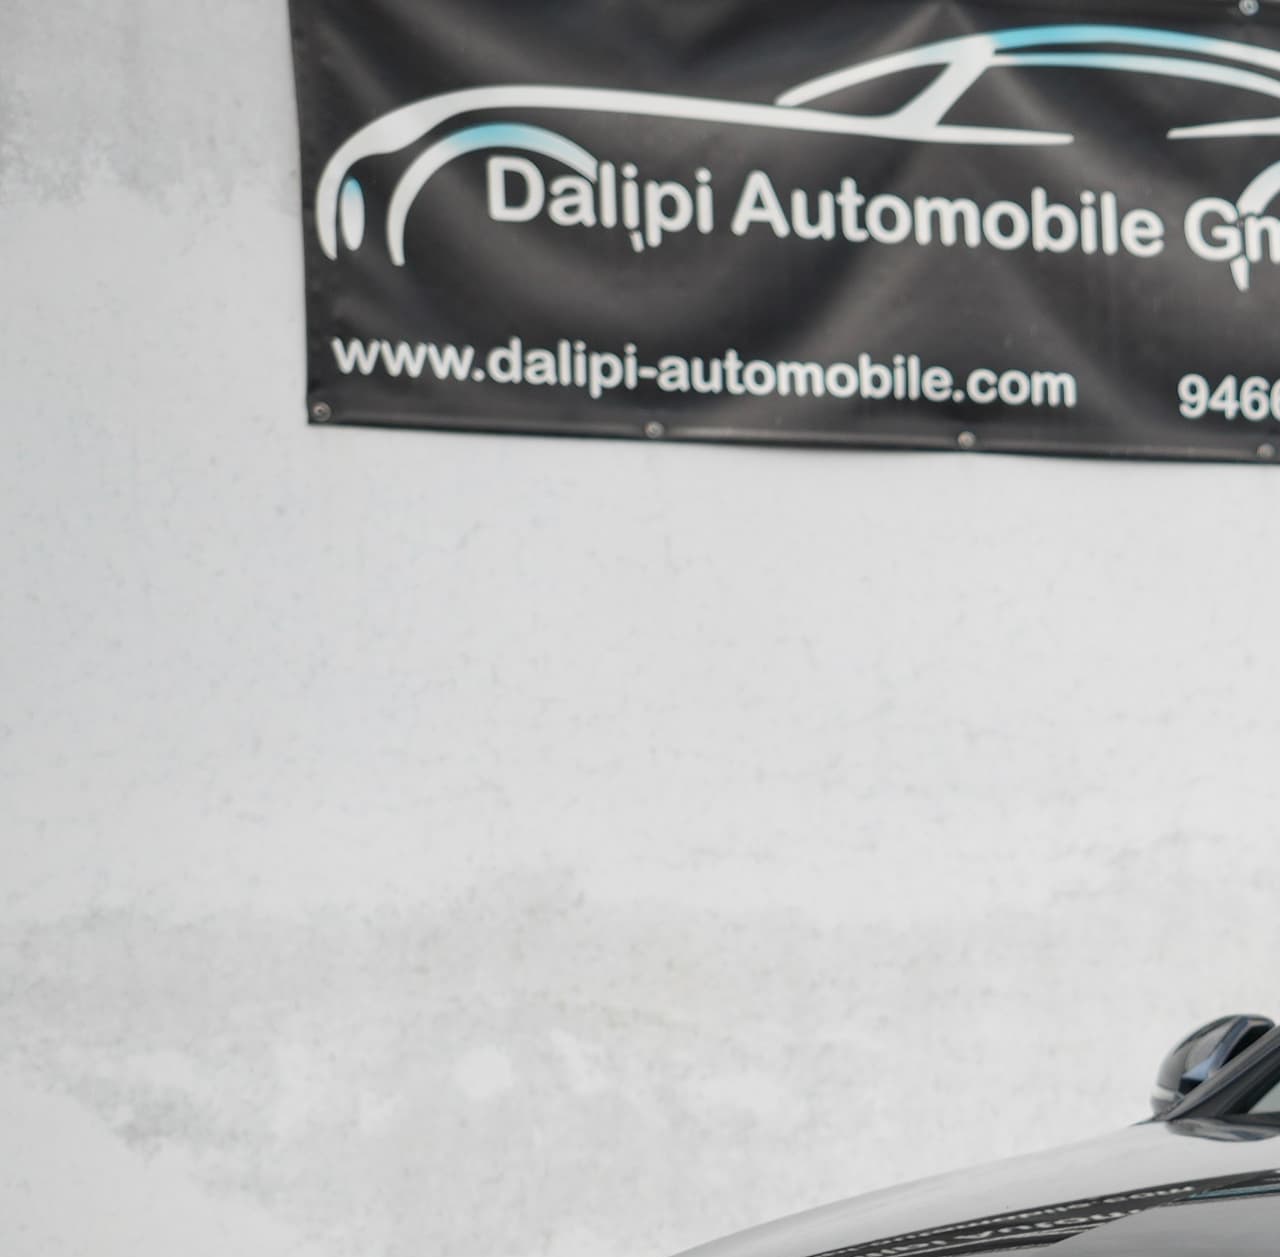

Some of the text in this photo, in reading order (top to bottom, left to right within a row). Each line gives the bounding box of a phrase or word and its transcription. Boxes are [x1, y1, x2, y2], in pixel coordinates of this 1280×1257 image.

[486, 156, 713, 248] Dalipi
[731, 170, 1165, 257] Automobile
[332, 337, 1077, 407] www.dalipi-automobile.com
